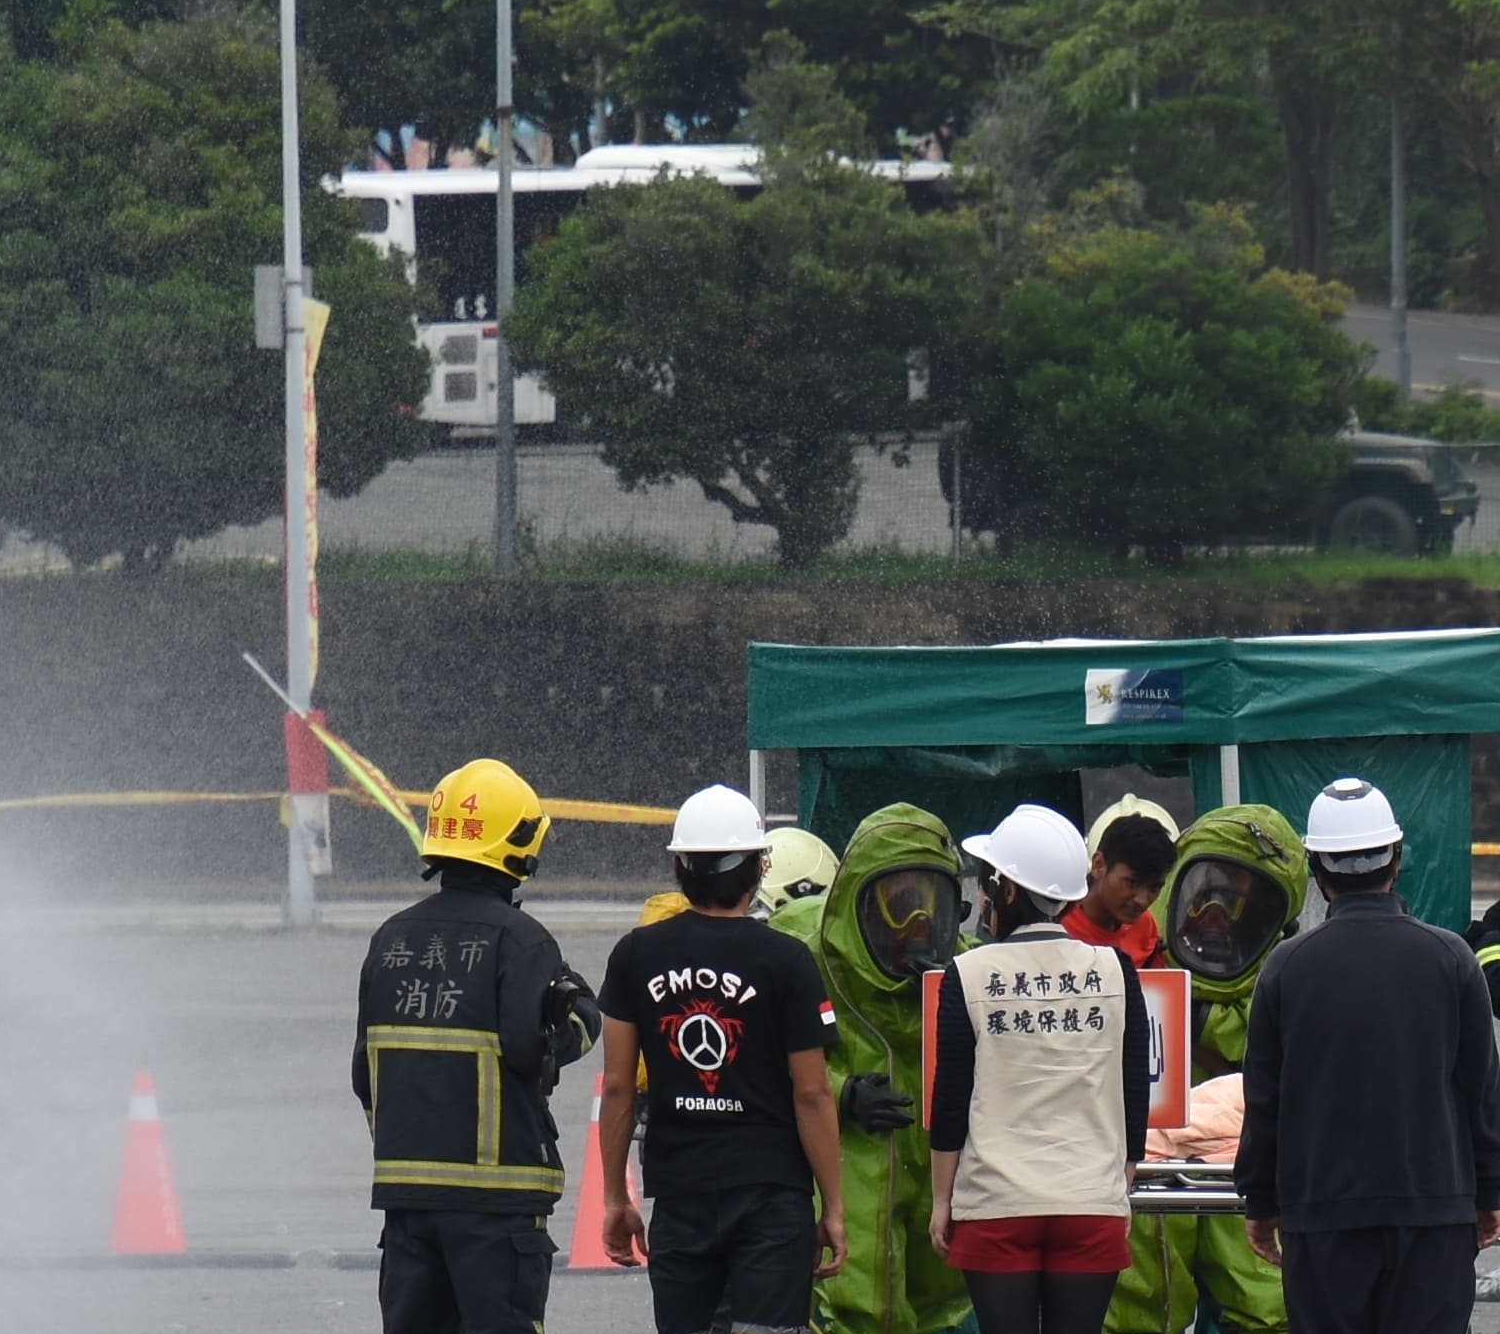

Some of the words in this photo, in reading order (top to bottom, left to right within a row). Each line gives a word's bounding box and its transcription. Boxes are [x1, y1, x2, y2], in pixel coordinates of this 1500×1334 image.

[381, 933, 490, 974] 嘉義市
[984, 969, 1104, 998] 嘉義市政府
[394, 978, 464, 1020] 消防
[986, 1006, 1106, 1035] 環境保護局
[675, 1096, 744, 1113] FORMOSA
